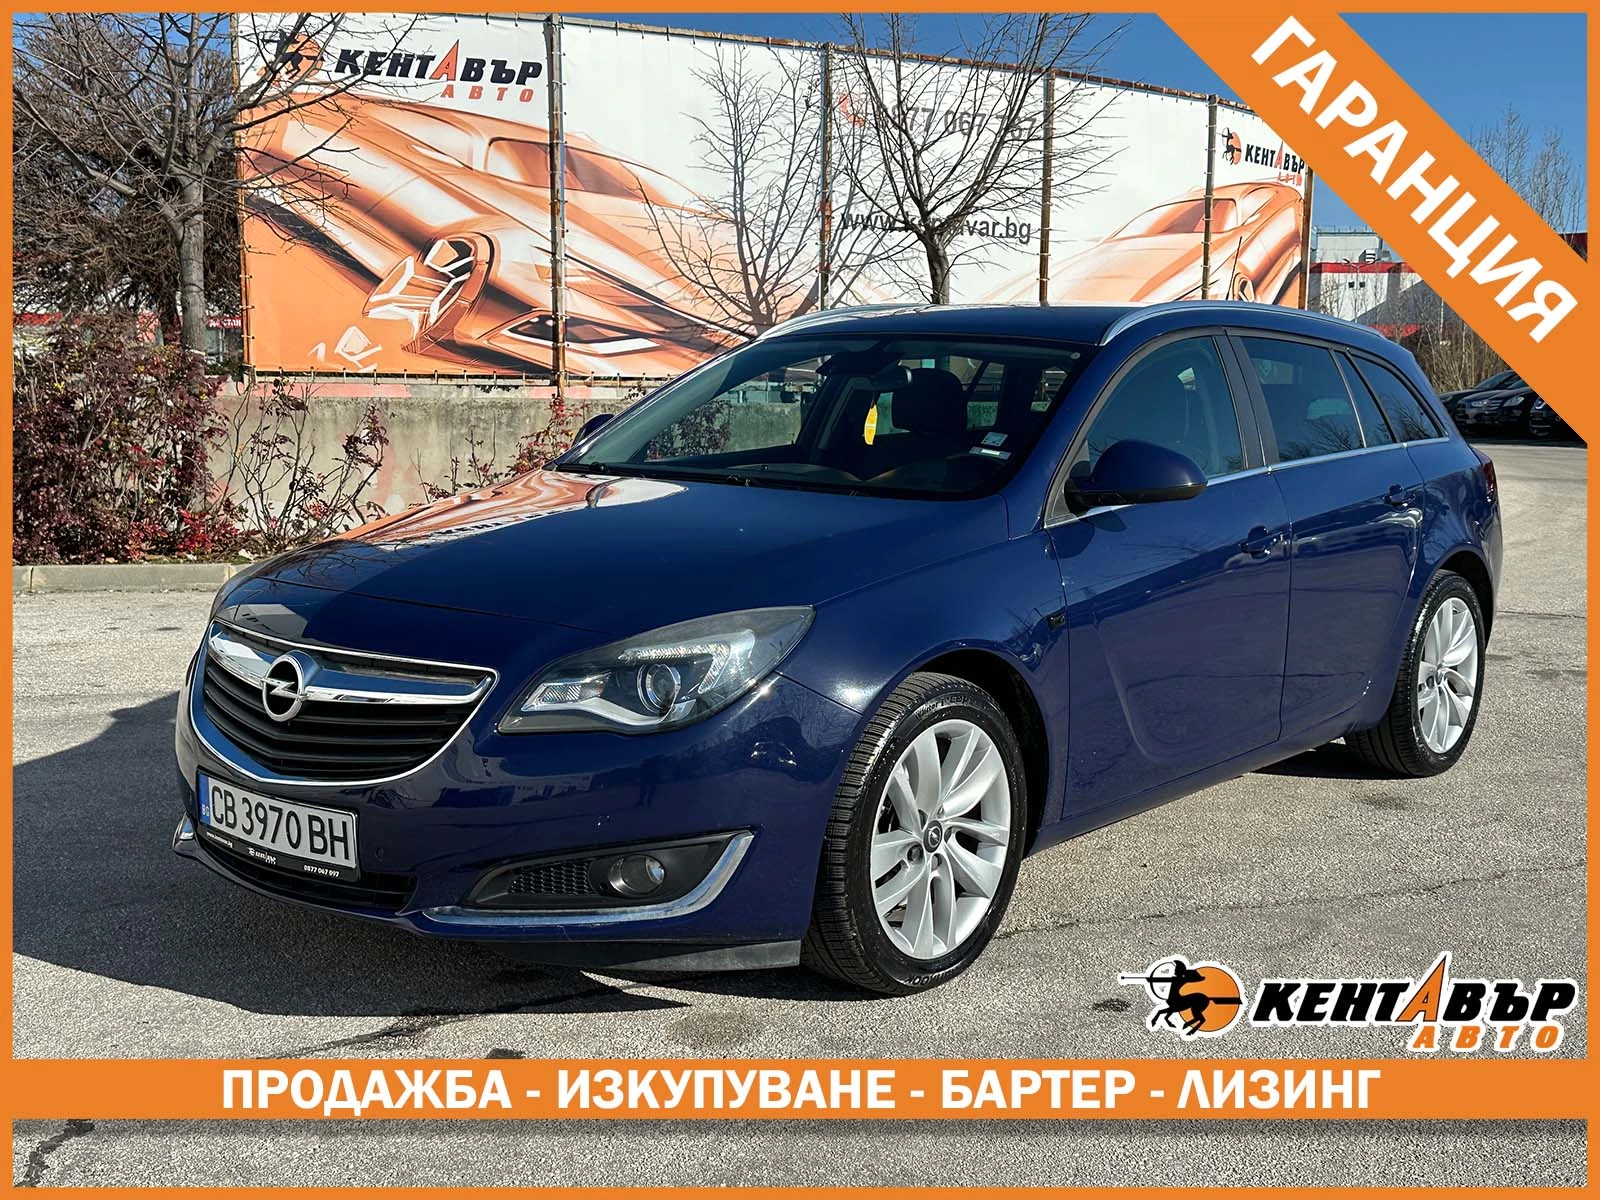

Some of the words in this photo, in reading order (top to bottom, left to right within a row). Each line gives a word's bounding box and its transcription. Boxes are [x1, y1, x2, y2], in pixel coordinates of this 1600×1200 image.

[334, 40, 543, 86] КЕНТАВЪР
[440, 84, 534, 103] АВТО
[944, 110, 986, 135] 067
[1245, 141, 1304, 174] КЕНТАВЪР
[211, 785, 237, 829] CB
[241, 797, 302, 850] 3970
[308, 814, 350, 860] BH
